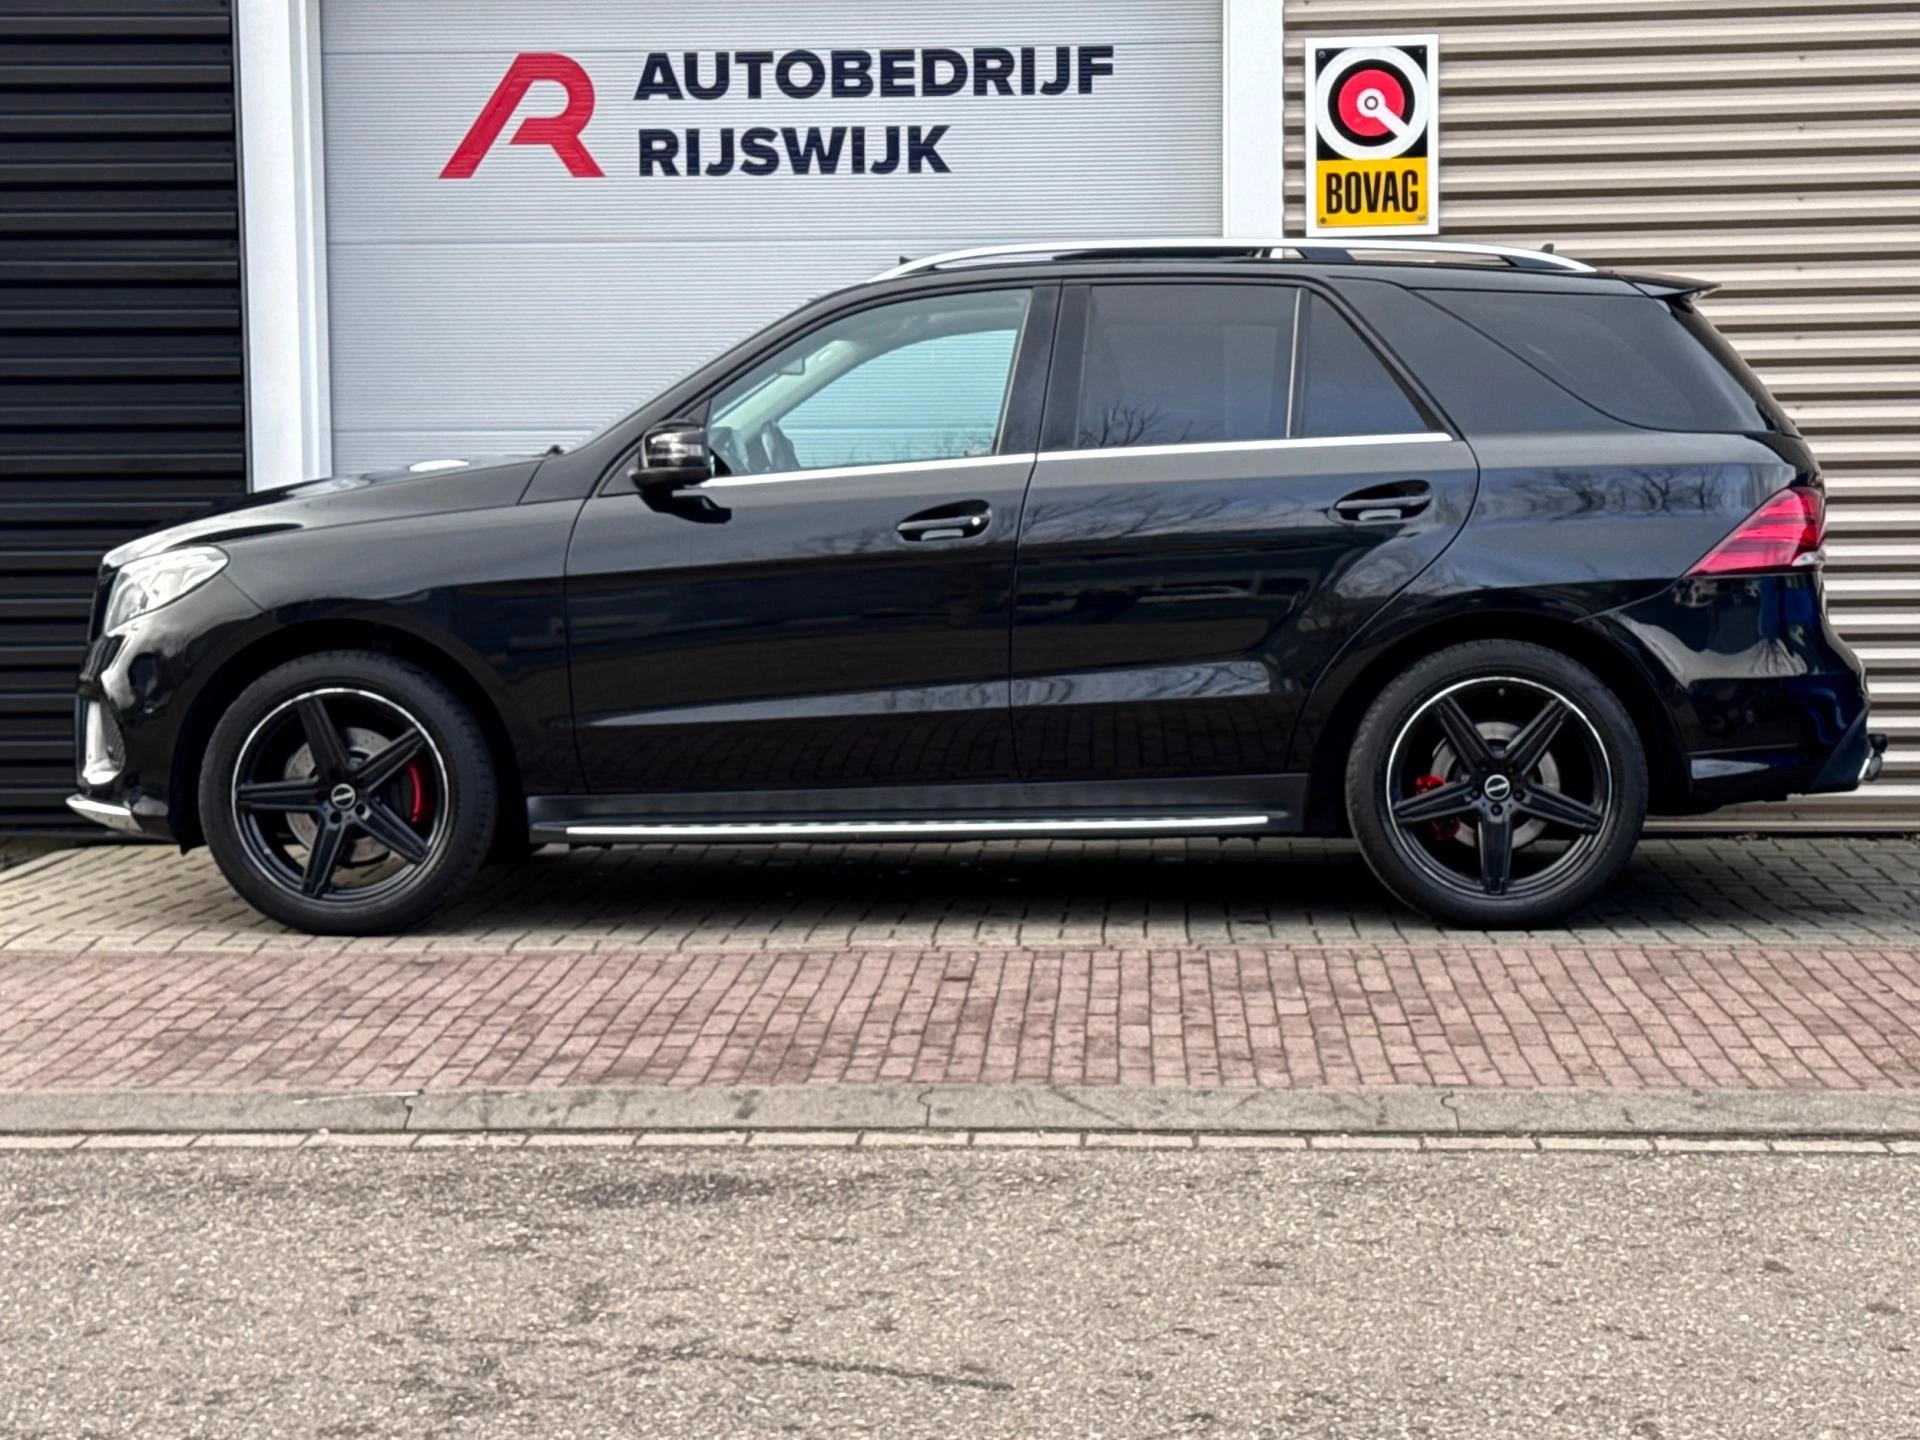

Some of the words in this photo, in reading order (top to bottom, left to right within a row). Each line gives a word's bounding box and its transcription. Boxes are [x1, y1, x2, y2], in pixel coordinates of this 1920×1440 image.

[633, 45, 1115, 101] AUTOBEDRIJF
[638, 125, 952, 177] RIJSWIJK
[1326, 169, 1419, 215] BOVAG
